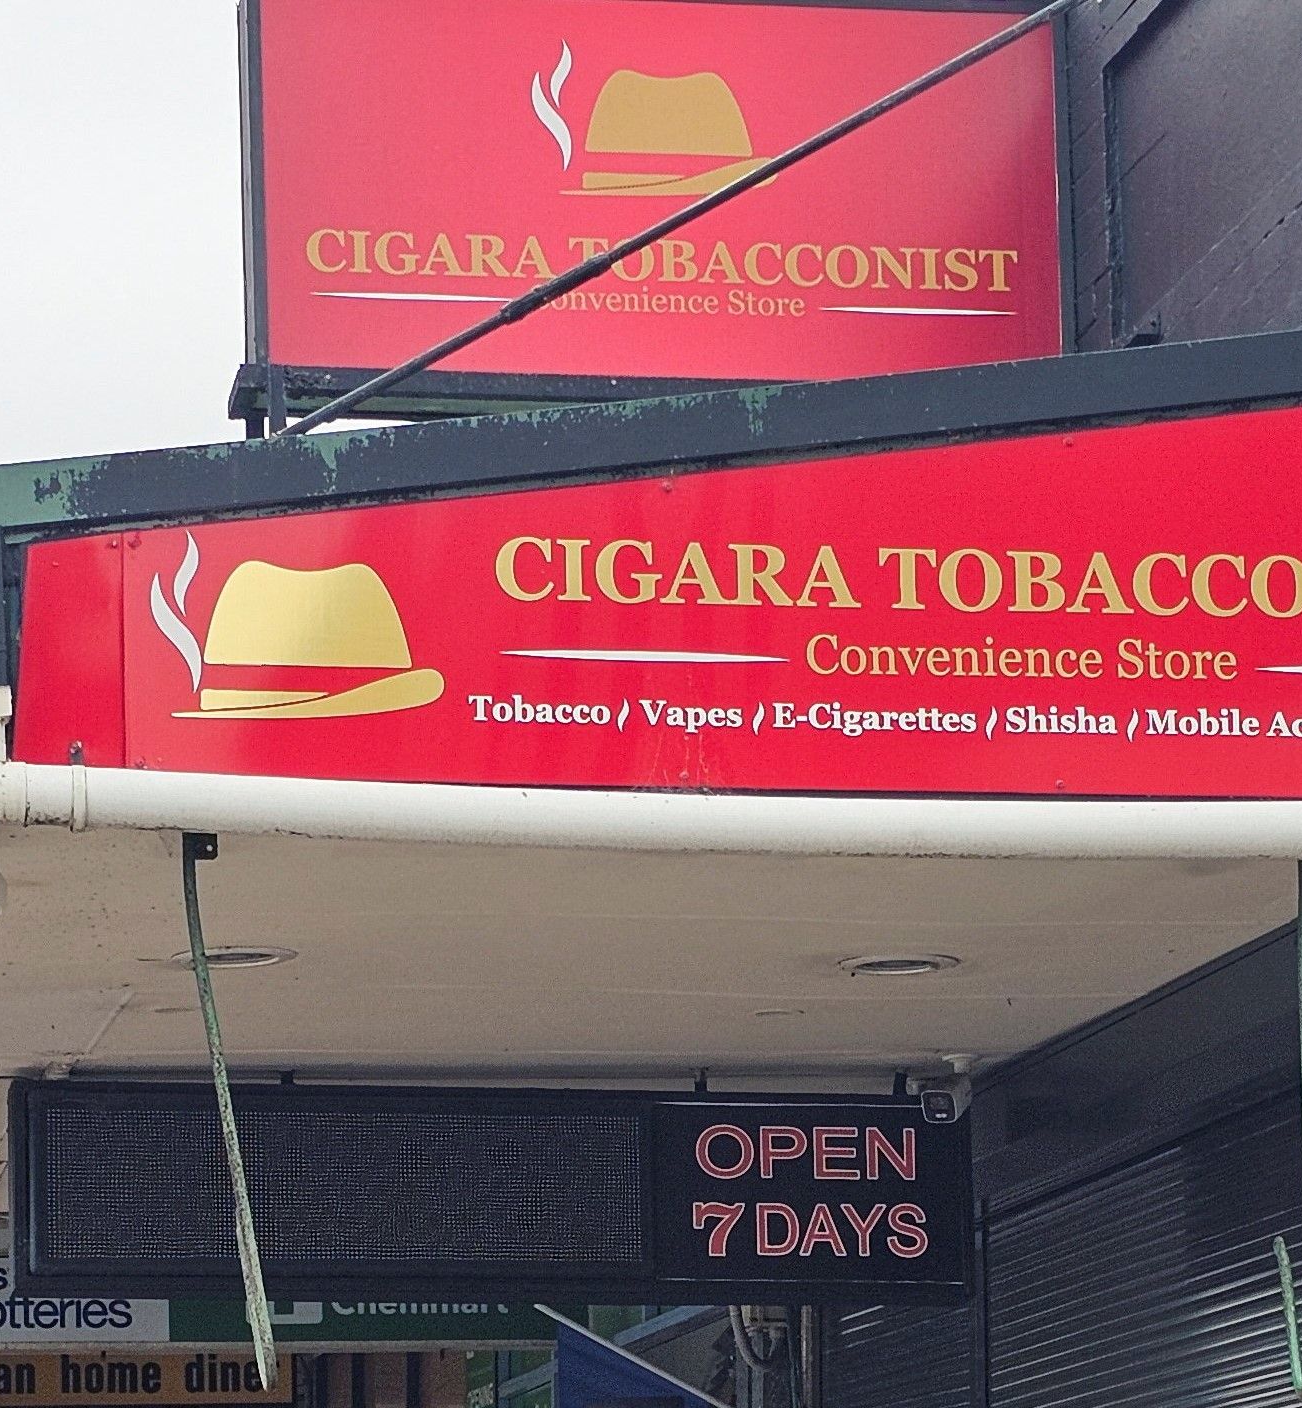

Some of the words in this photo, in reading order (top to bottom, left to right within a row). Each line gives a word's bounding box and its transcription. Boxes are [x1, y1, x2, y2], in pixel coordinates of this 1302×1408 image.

[305, 228, 556, 279] CIGARA
[568, 235, 1019, 293] TOBACCONIST
[539, 285, 720, 315] onvenience
[727, 289, 806, 317] Store
[495, 536, 861, 610] CIGARA
[805, 633, 1104, 681] Convenience
[1116, 637, 1239, 683] Store
[468, 694, 611, 725] Tobacco
[639, 699, 743, 734] Vapes
[772, 702, 977, 737] E-Cigarettes
[1005, 706, 1118, 735] Shisha
[1145, 708, 1261, 738] Mobile
[695, 1124, 917, 1181] OPEN
[692, 1201, 745, 1257] 7
[755, 1203, 929, 1259] DAYS
[61, 1353, 161, 1395] home
[184, 1352, 279, 1394] dine
